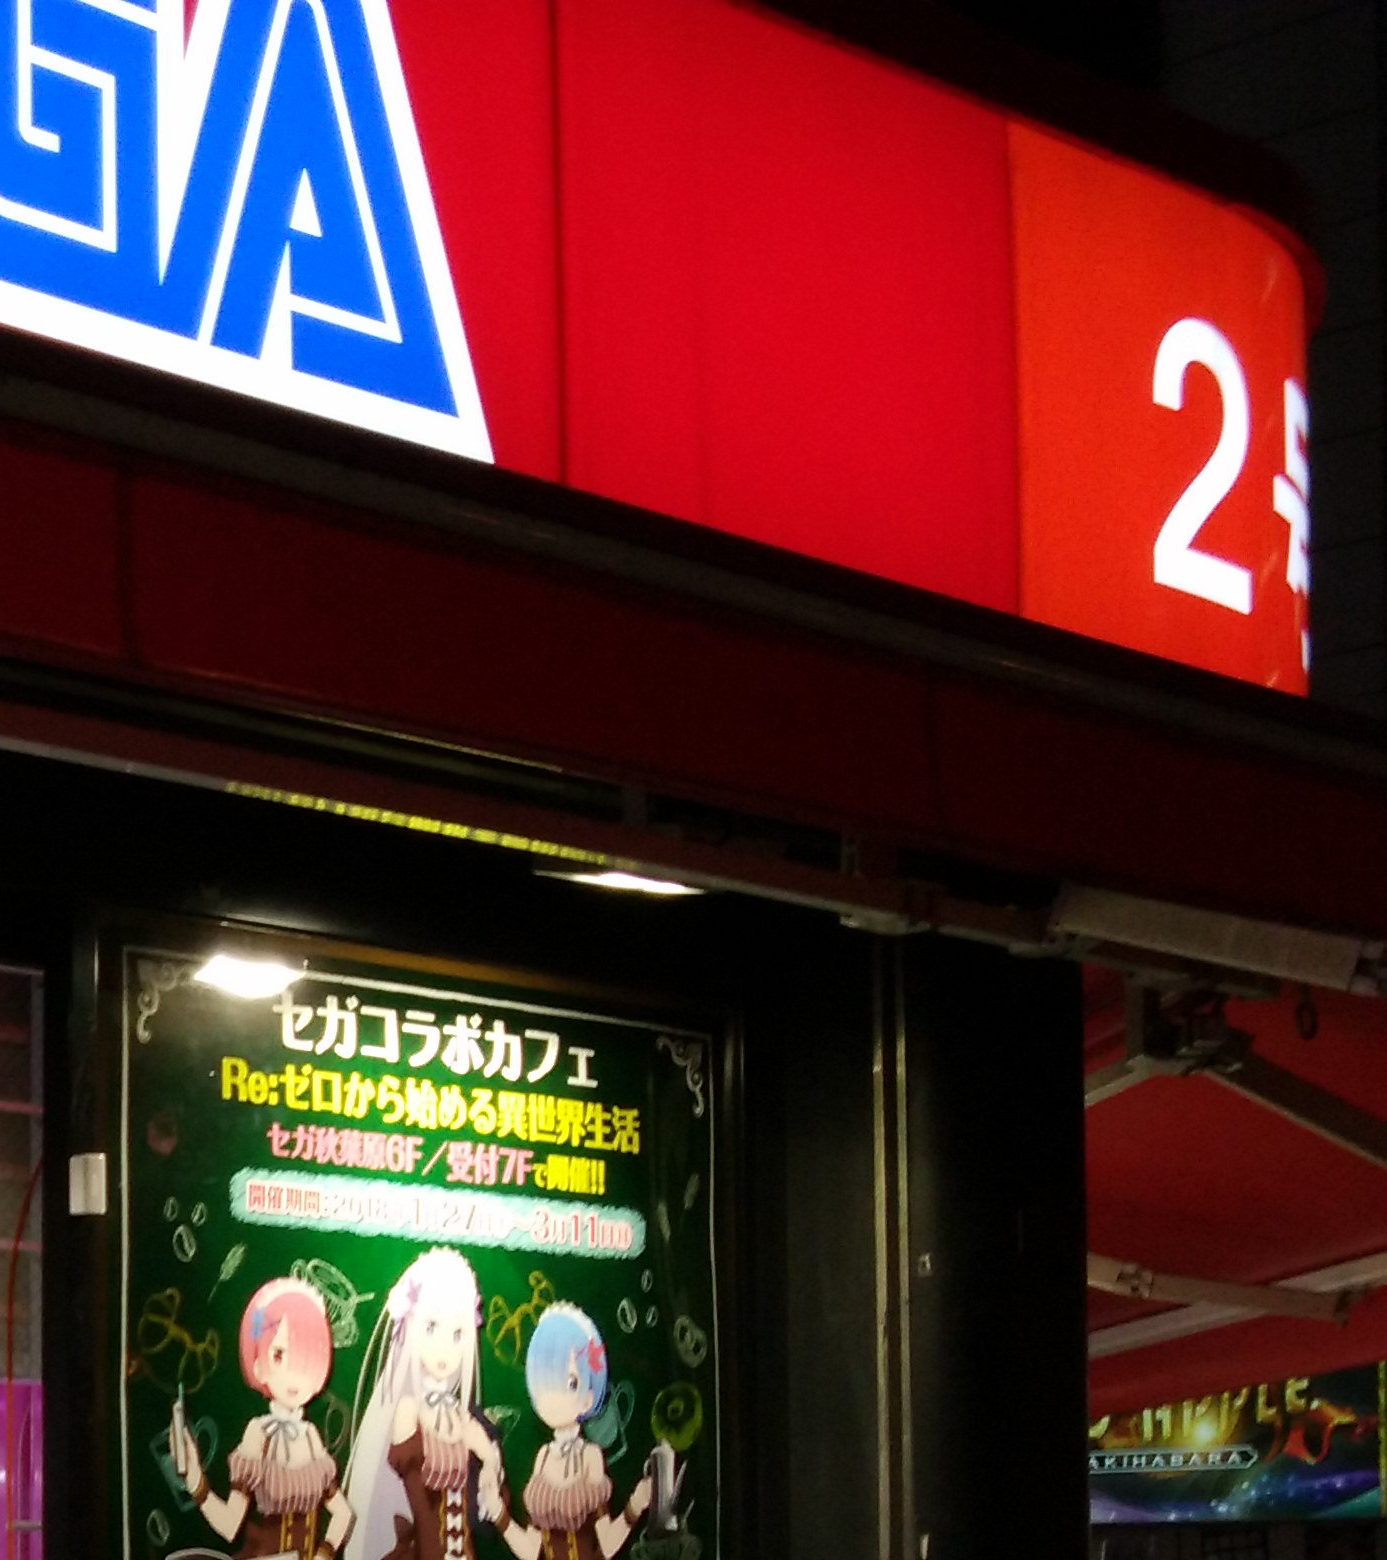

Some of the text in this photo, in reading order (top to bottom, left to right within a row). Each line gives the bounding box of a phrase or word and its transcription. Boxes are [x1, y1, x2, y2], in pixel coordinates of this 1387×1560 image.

[273, 992, 598, 1088] セガコラボカフェ
[222, 1056, 639, 1153] Re:ゼロから始める異世界生活
